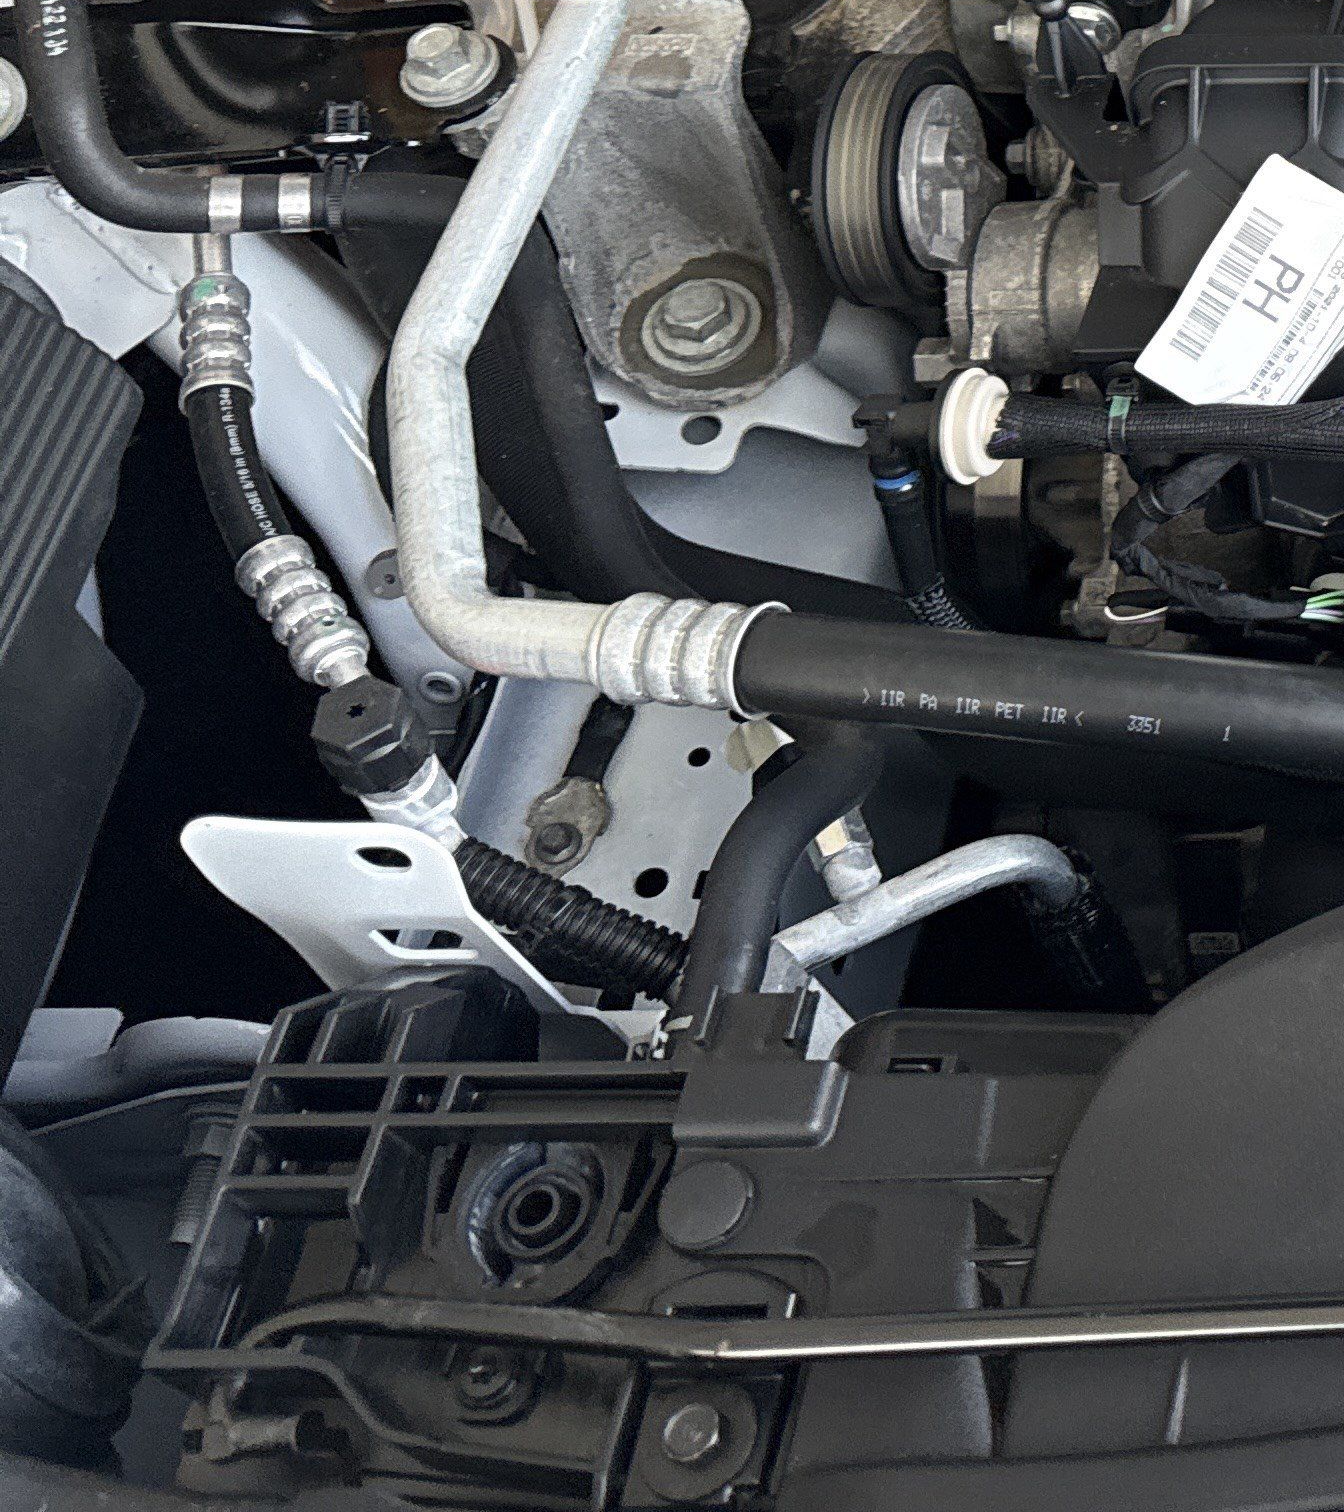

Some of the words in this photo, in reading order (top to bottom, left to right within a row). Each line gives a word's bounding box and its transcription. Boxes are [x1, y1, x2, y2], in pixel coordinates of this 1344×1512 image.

[1241, 253, 1306, 324] PH
[244, 490, 270, 520] HOSE
[880, 688, 906, 708] IIR
[918, 692, 938, 711] PA
[955, 696, 981, 716] IIR
[994, 701, 1026, 720] PET
[1126, 714, 1162, 735] 3351
